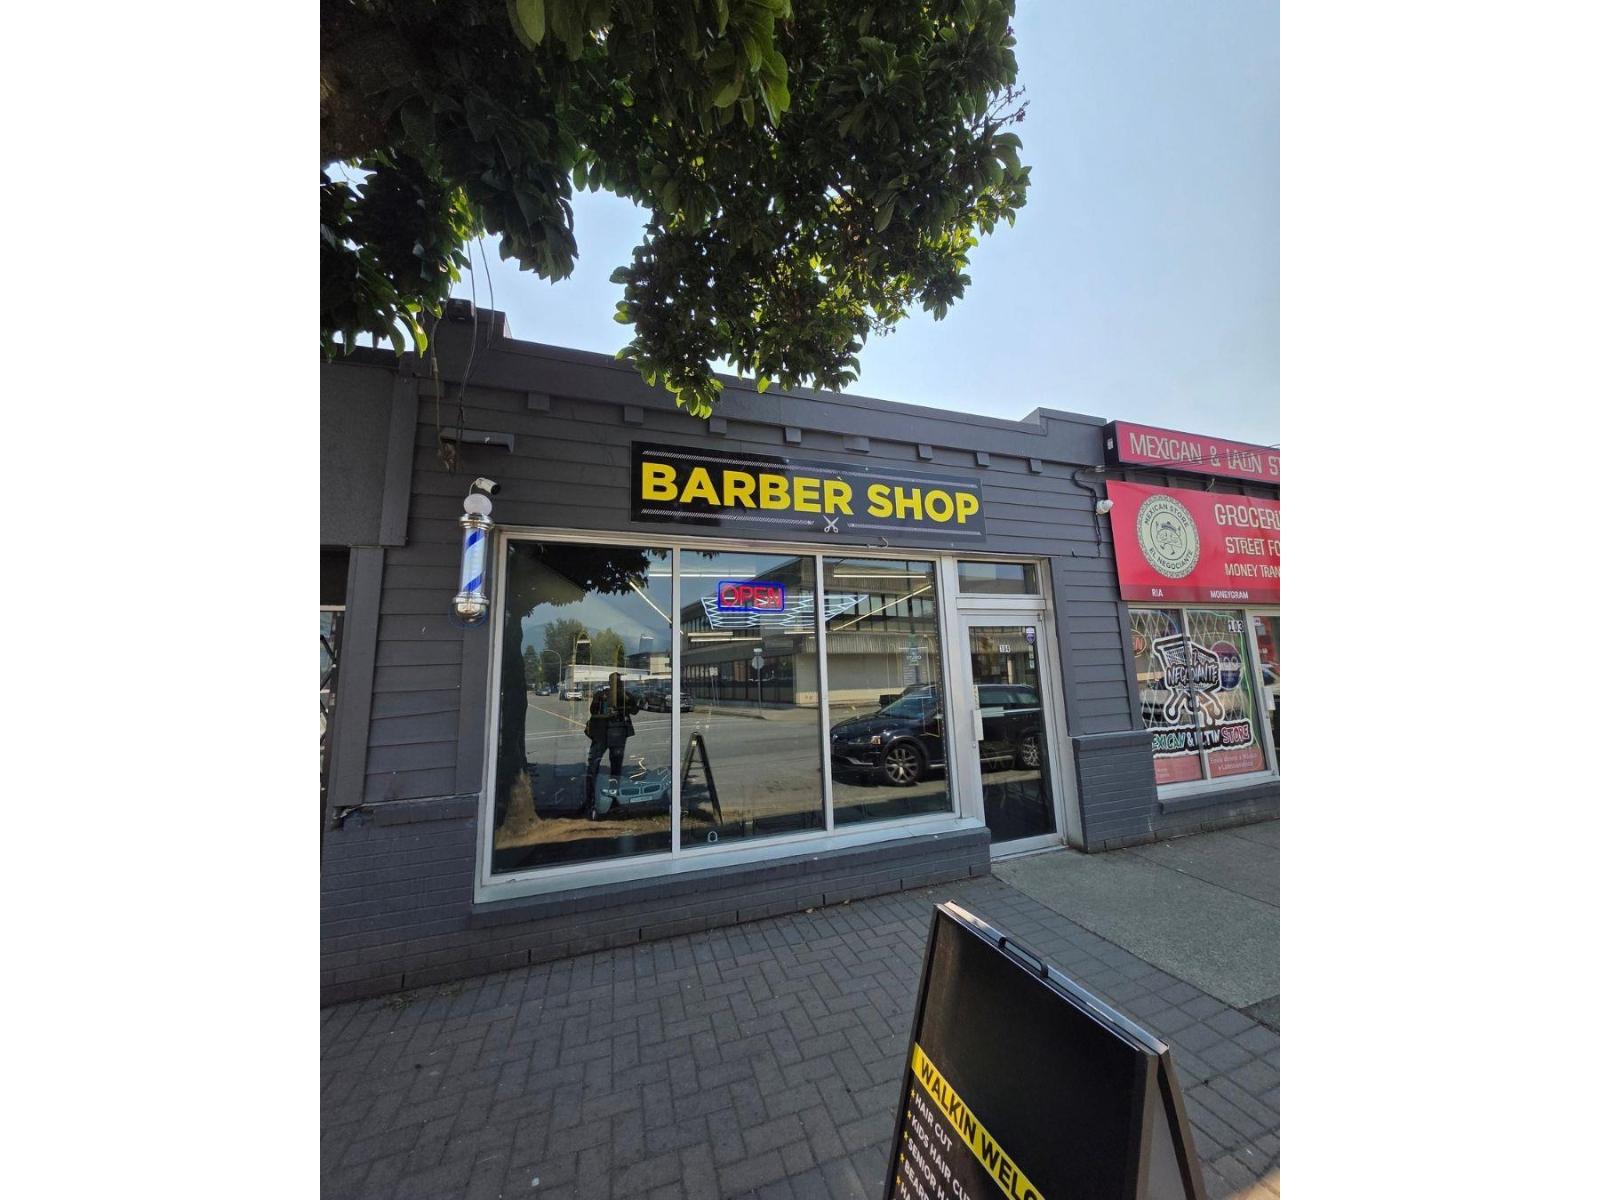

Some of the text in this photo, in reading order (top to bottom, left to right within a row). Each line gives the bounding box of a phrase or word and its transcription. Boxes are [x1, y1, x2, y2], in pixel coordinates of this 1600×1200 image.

[1129, 432, 1203, 465] MEXICAN
[1209, 445, 1221, 467] &
[641, 461, 980, 524] BARBER SHOP
[1144, 503, 1190, 528] MEXICAN STORE
[1149, 547, 1158, 559] EL
[1225, 536, 1265, 556] STREET
[1224, 563, 1258, 577] MONEY
[721, 584, 783, 608] OPEN
[1151, 588, 1164, 598] RIA
[1210, 590, 1249, 599] MONEYGRAM
[1151, 732, 1186, 750] EXICAN
[1186, 731, 1195, 747] &
[1221, 724, 1250, 744] STORE
[921, 1057, 977, 1145] WALKIN
[915, 1093, 953, 1152] HAIR CUT
[911, 1115, 929, 1148] KIDS
[929, 1142, 952, 1183] HAIR
[907, 1137, 937, 1191] SENIOR
